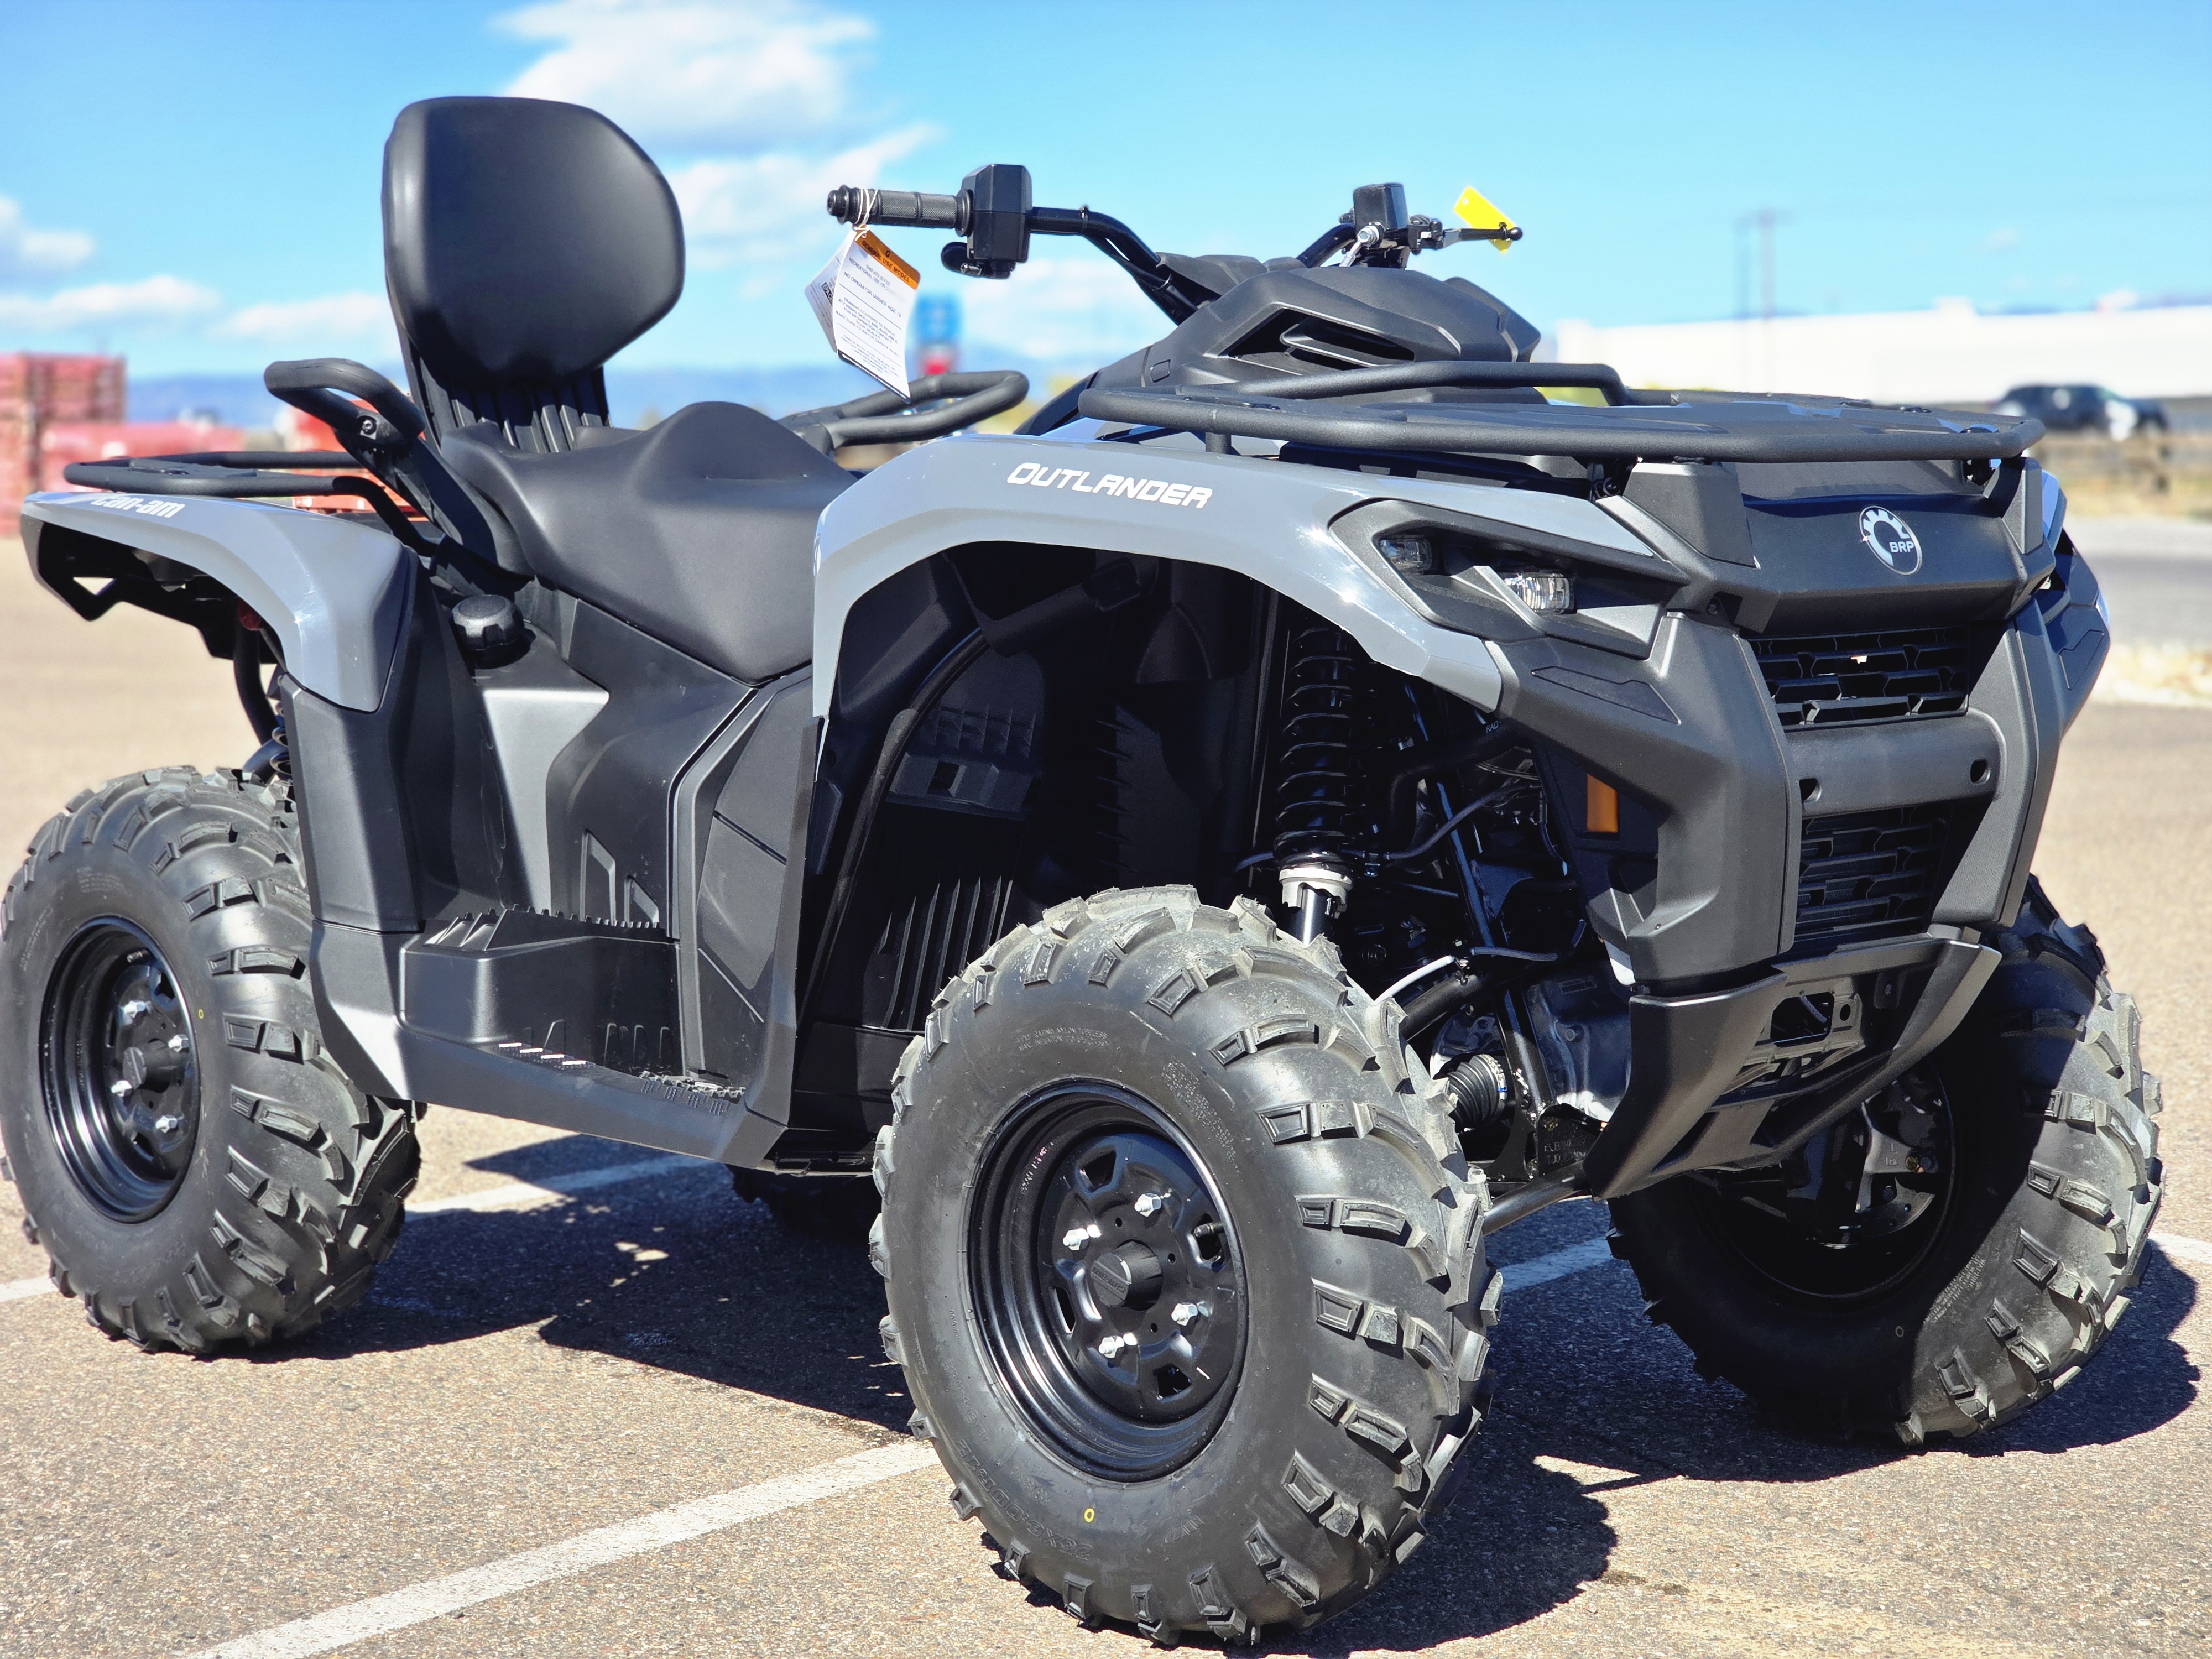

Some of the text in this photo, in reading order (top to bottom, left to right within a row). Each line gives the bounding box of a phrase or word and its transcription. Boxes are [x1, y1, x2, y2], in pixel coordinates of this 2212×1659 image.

[882, 258, 892, 269] USE
[893, 266, 910, 283] MODEL
[844, 270, 850, 279] NO
[851, 275, 872, 296] OPERATOR
[873, 293, 886, 306] UNDER
[887, 304, 895, 314] AGE
[1007, 462, 1213, 509] OUTLANDER
[91, 497, 185, 518] can-am
[1889, 541, 1914, 553] BRP
[1486, 721, 1499, 734] RAD
